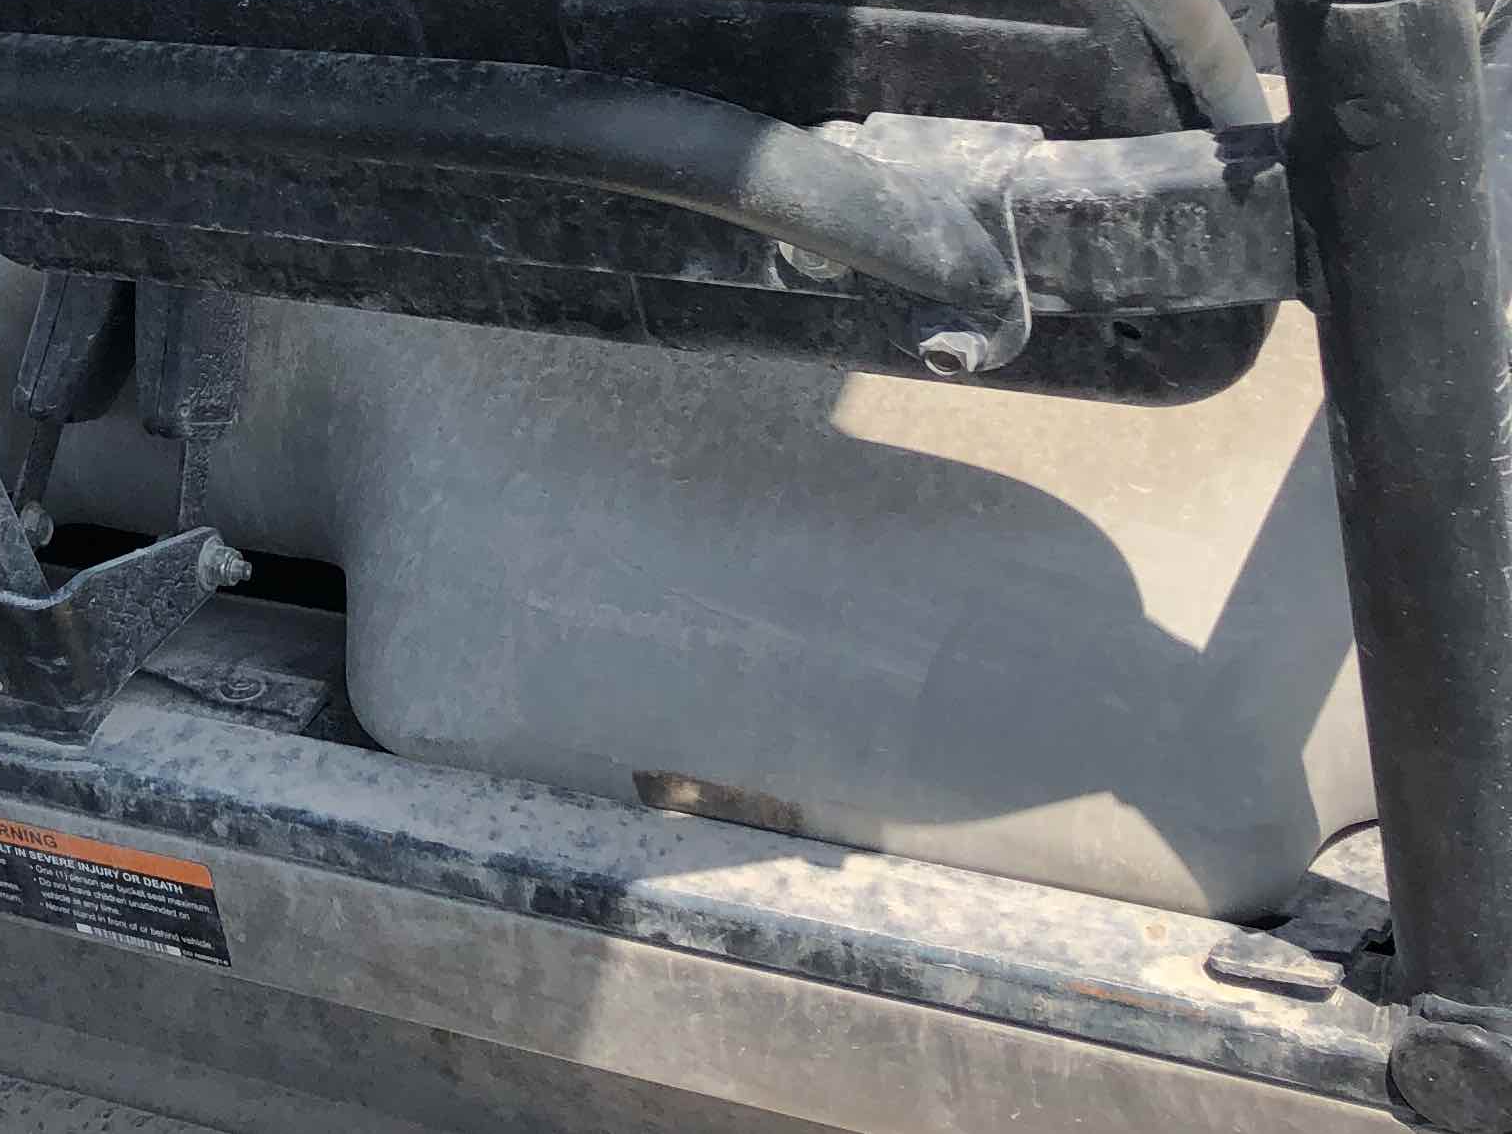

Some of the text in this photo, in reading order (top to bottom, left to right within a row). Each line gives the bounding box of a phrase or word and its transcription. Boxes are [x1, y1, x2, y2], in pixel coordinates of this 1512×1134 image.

[13, 846, 27, 858] IN
[28, 849, 75, 870] SEVERE
[76, 861, 119, 880] INJURY
[121, 871, 141, 885] OR
[142, 876, 183, 895] DEATH
